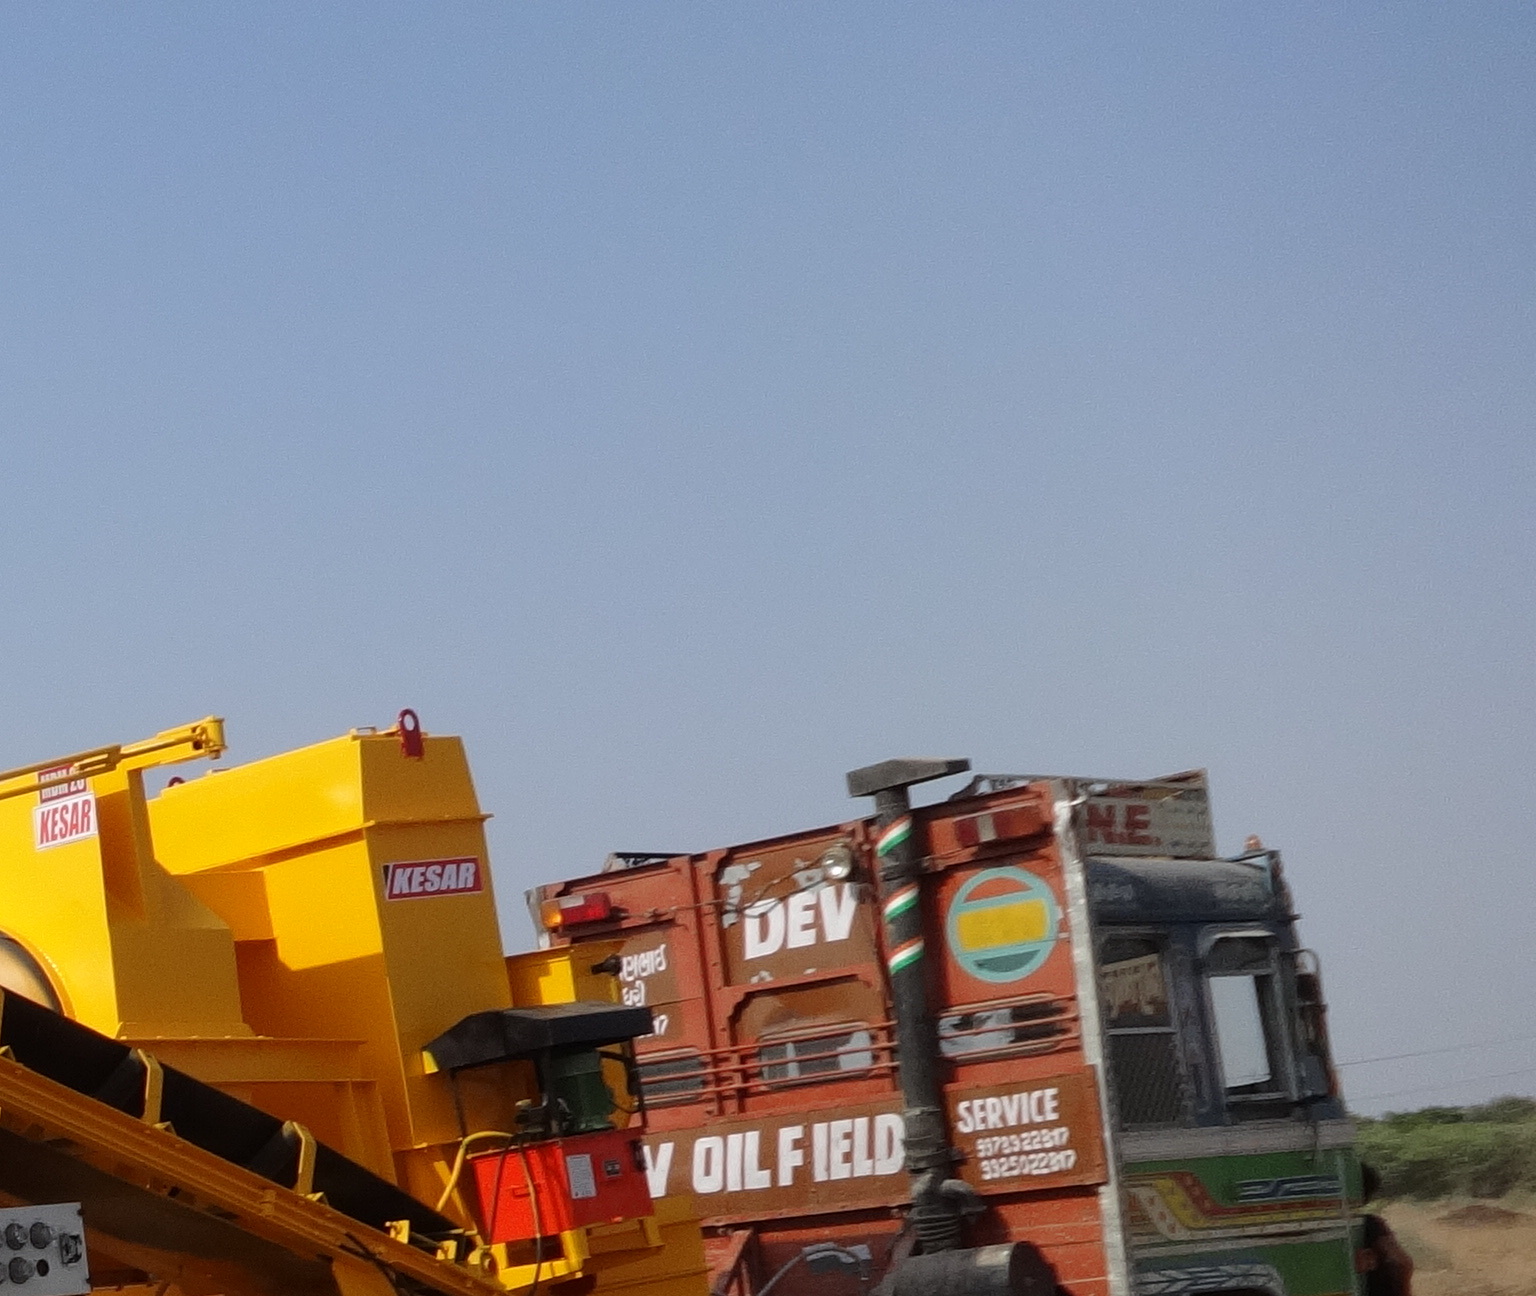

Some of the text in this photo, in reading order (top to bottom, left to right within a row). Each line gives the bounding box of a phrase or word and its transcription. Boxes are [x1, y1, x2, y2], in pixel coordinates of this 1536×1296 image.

[39, 799, 92, 845] KESAR
[392, 862, 476, 895] KESAR
[744, 881, 858, 961] DEV
[957, 1087, 1060, 1134] SERVICE
